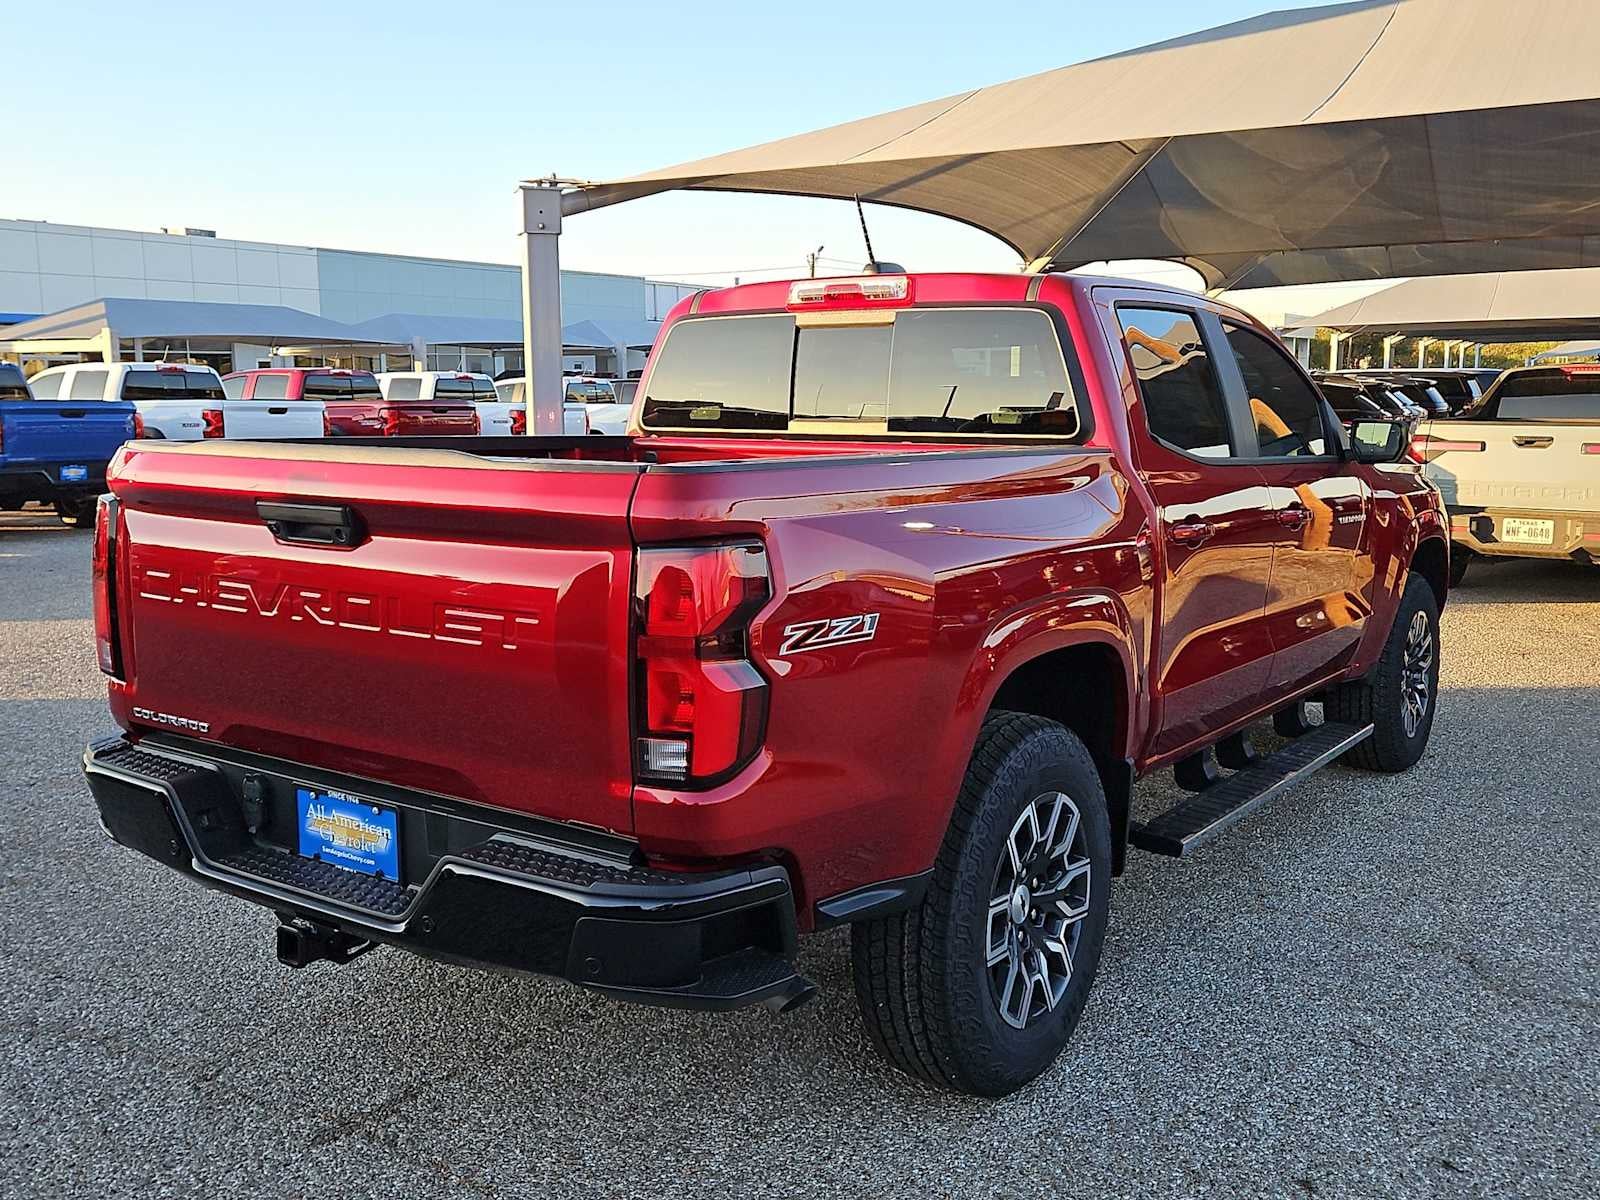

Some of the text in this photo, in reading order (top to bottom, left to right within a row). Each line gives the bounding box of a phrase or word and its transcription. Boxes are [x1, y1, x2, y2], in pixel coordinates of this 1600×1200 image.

[139, 570, 540, 650] CHEVROLET
[779, 612, 880, 656] Z71
[132, 706, 210, 733] COLORADO
[327, 790, 346, 801] SINCE
[306, 803, 392, 840] All American
[320, 823, 376, 854] Chevrolet
